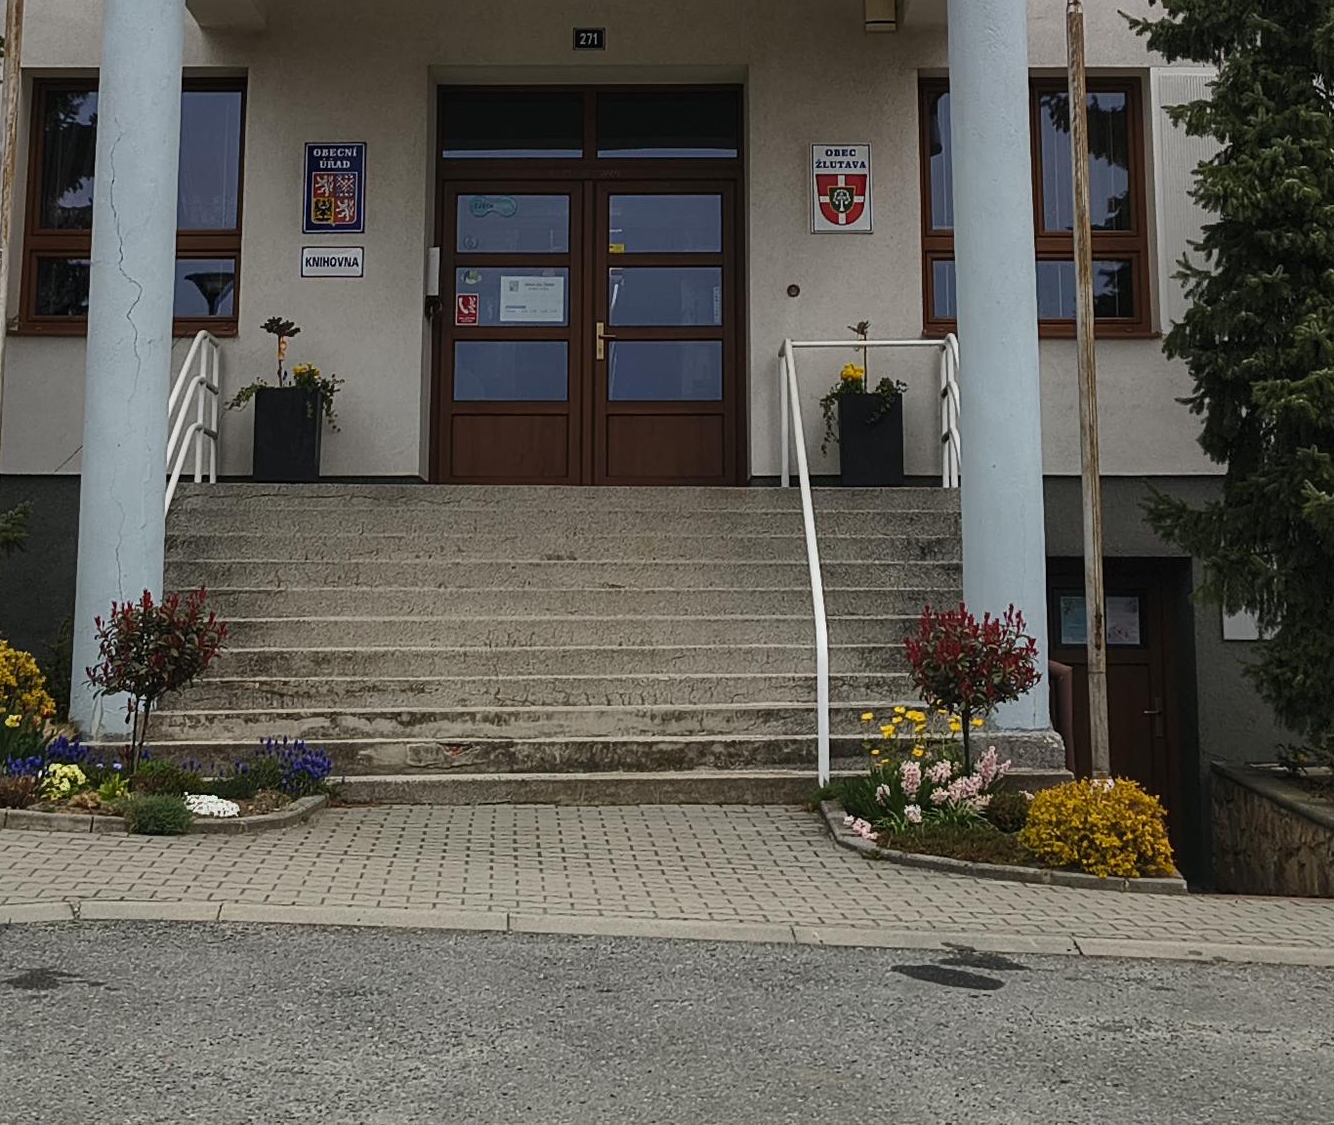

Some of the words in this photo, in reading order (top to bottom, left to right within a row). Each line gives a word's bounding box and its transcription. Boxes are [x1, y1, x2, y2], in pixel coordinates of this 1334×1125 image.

[579, 32, 598, 45] 271
[313, 147, 357, 158] OBECNÍ
[825, 148, 857, 157] OBEC
[815, 159, 867, 169] ŽLUTAVA
[305, 256, 359, 268] KNIHOVNA
